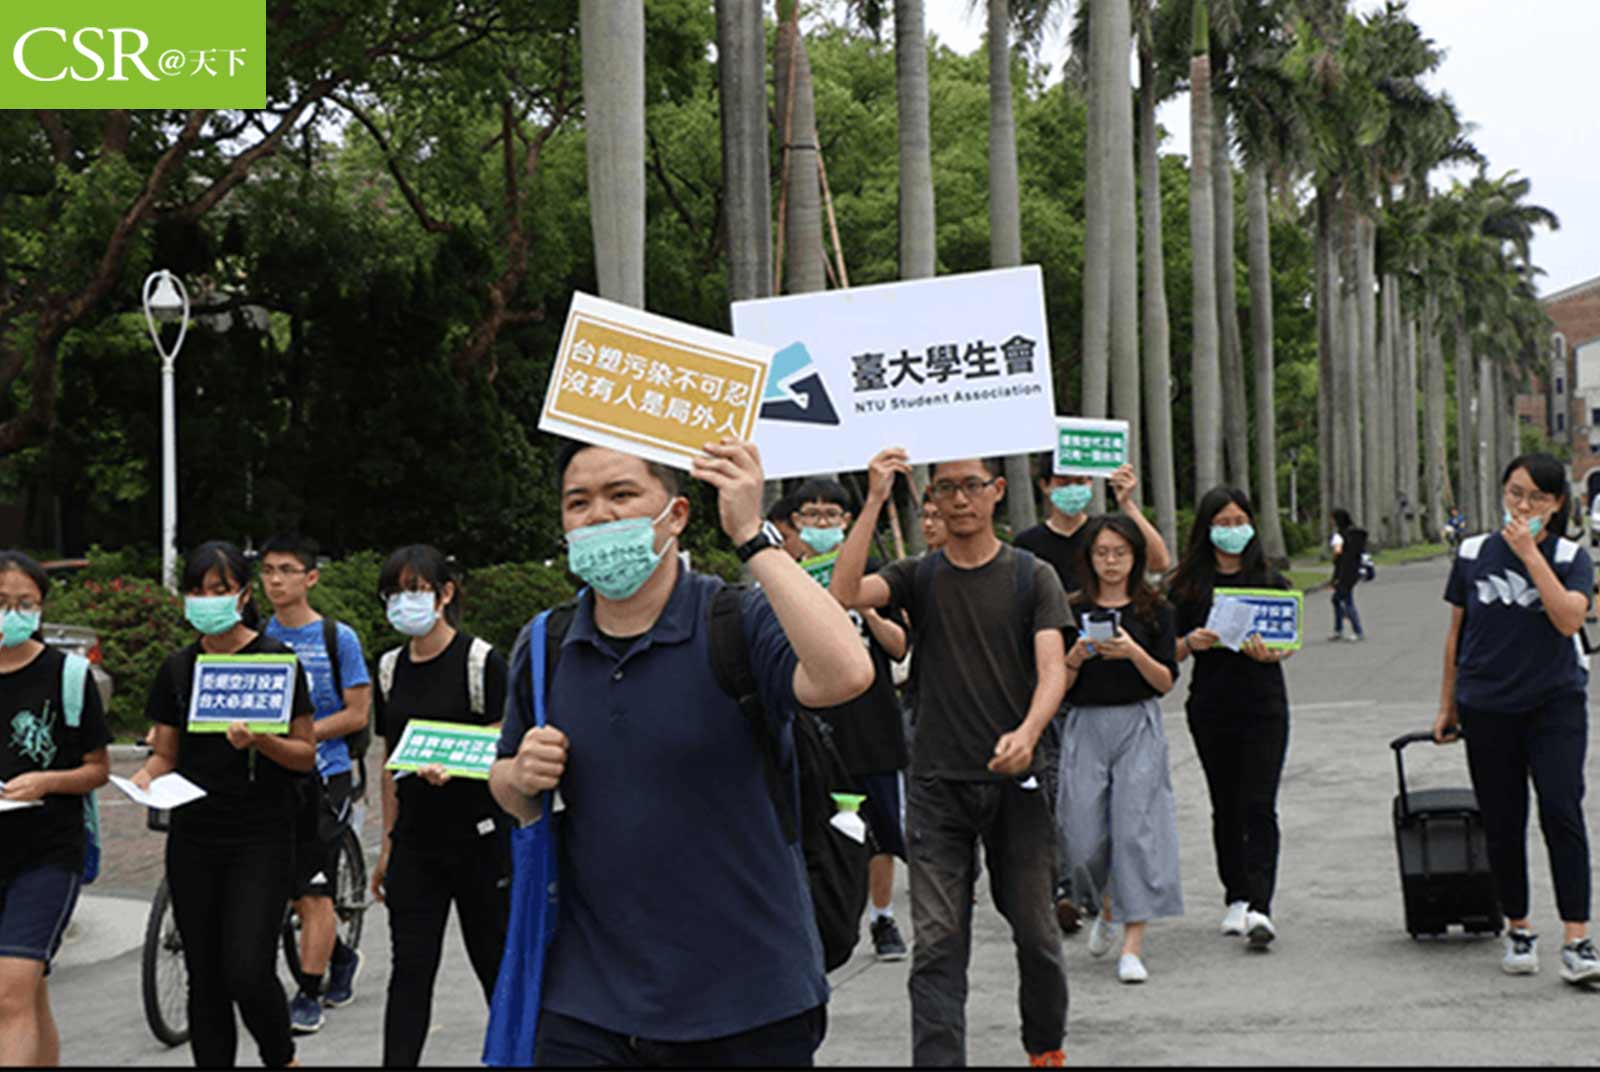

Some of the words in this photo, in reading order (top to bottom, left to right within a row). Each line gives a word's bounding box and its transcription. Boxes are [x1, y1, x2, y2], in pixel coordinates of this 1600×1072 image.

[570, 338, 751, 407] 台塑污染不可忍
[850, 334, 1038, 393] 臺大學生會
[562, 367, 740, 435] 沒有人是局外人
[854, 400, 886, 414] NTU
[891, 392, 949, 410] Student
[953, 383, 1042, 402] Association
